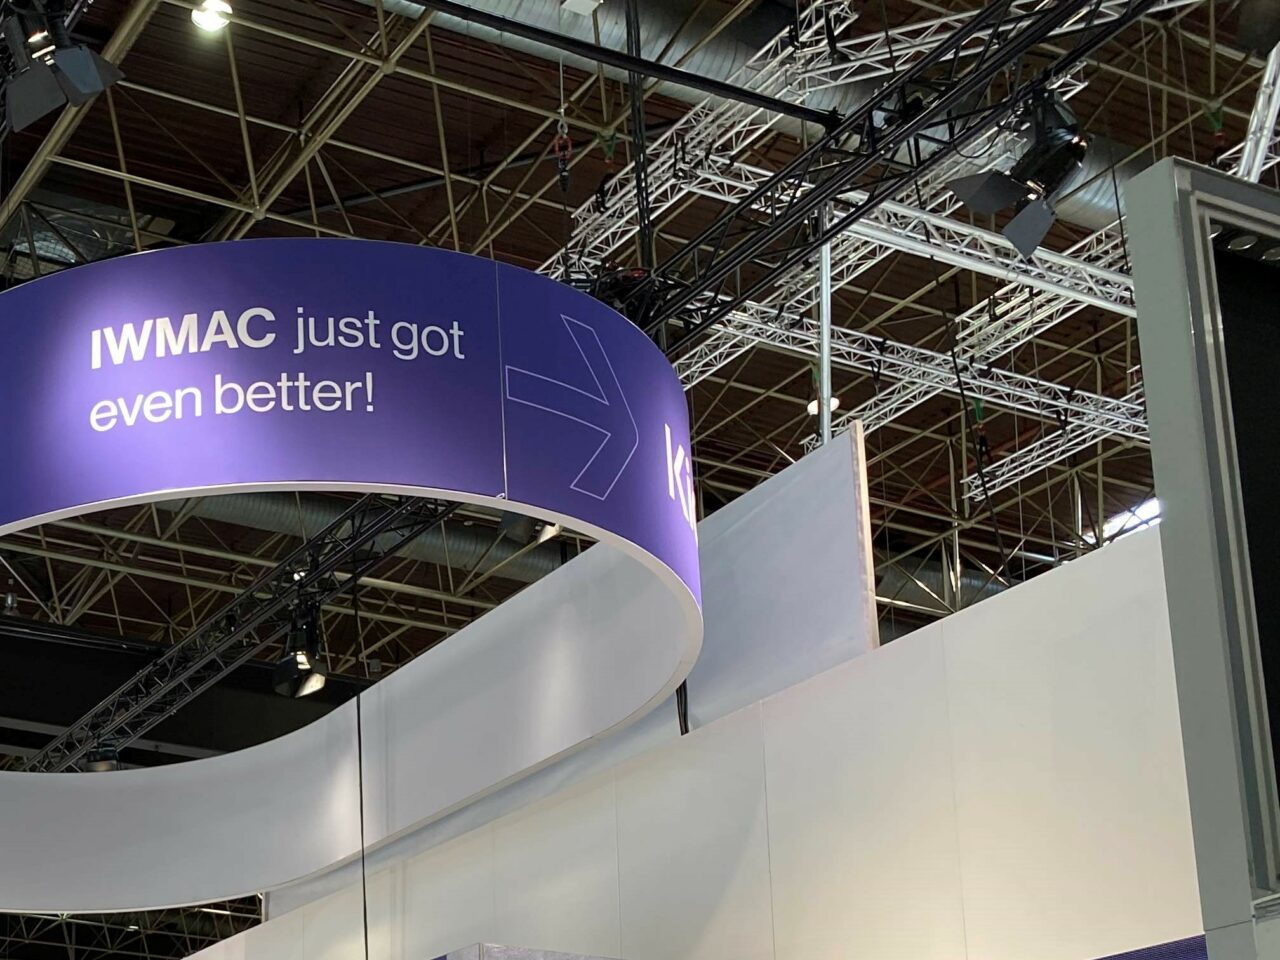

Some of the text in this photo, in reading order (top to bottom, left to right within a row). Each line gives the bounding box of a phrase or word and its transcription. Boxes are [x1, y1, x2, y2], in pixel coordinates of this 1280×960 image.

[91, 306, 465, 369] IWMAC just got
[89, 371, 375, 432] even better!
